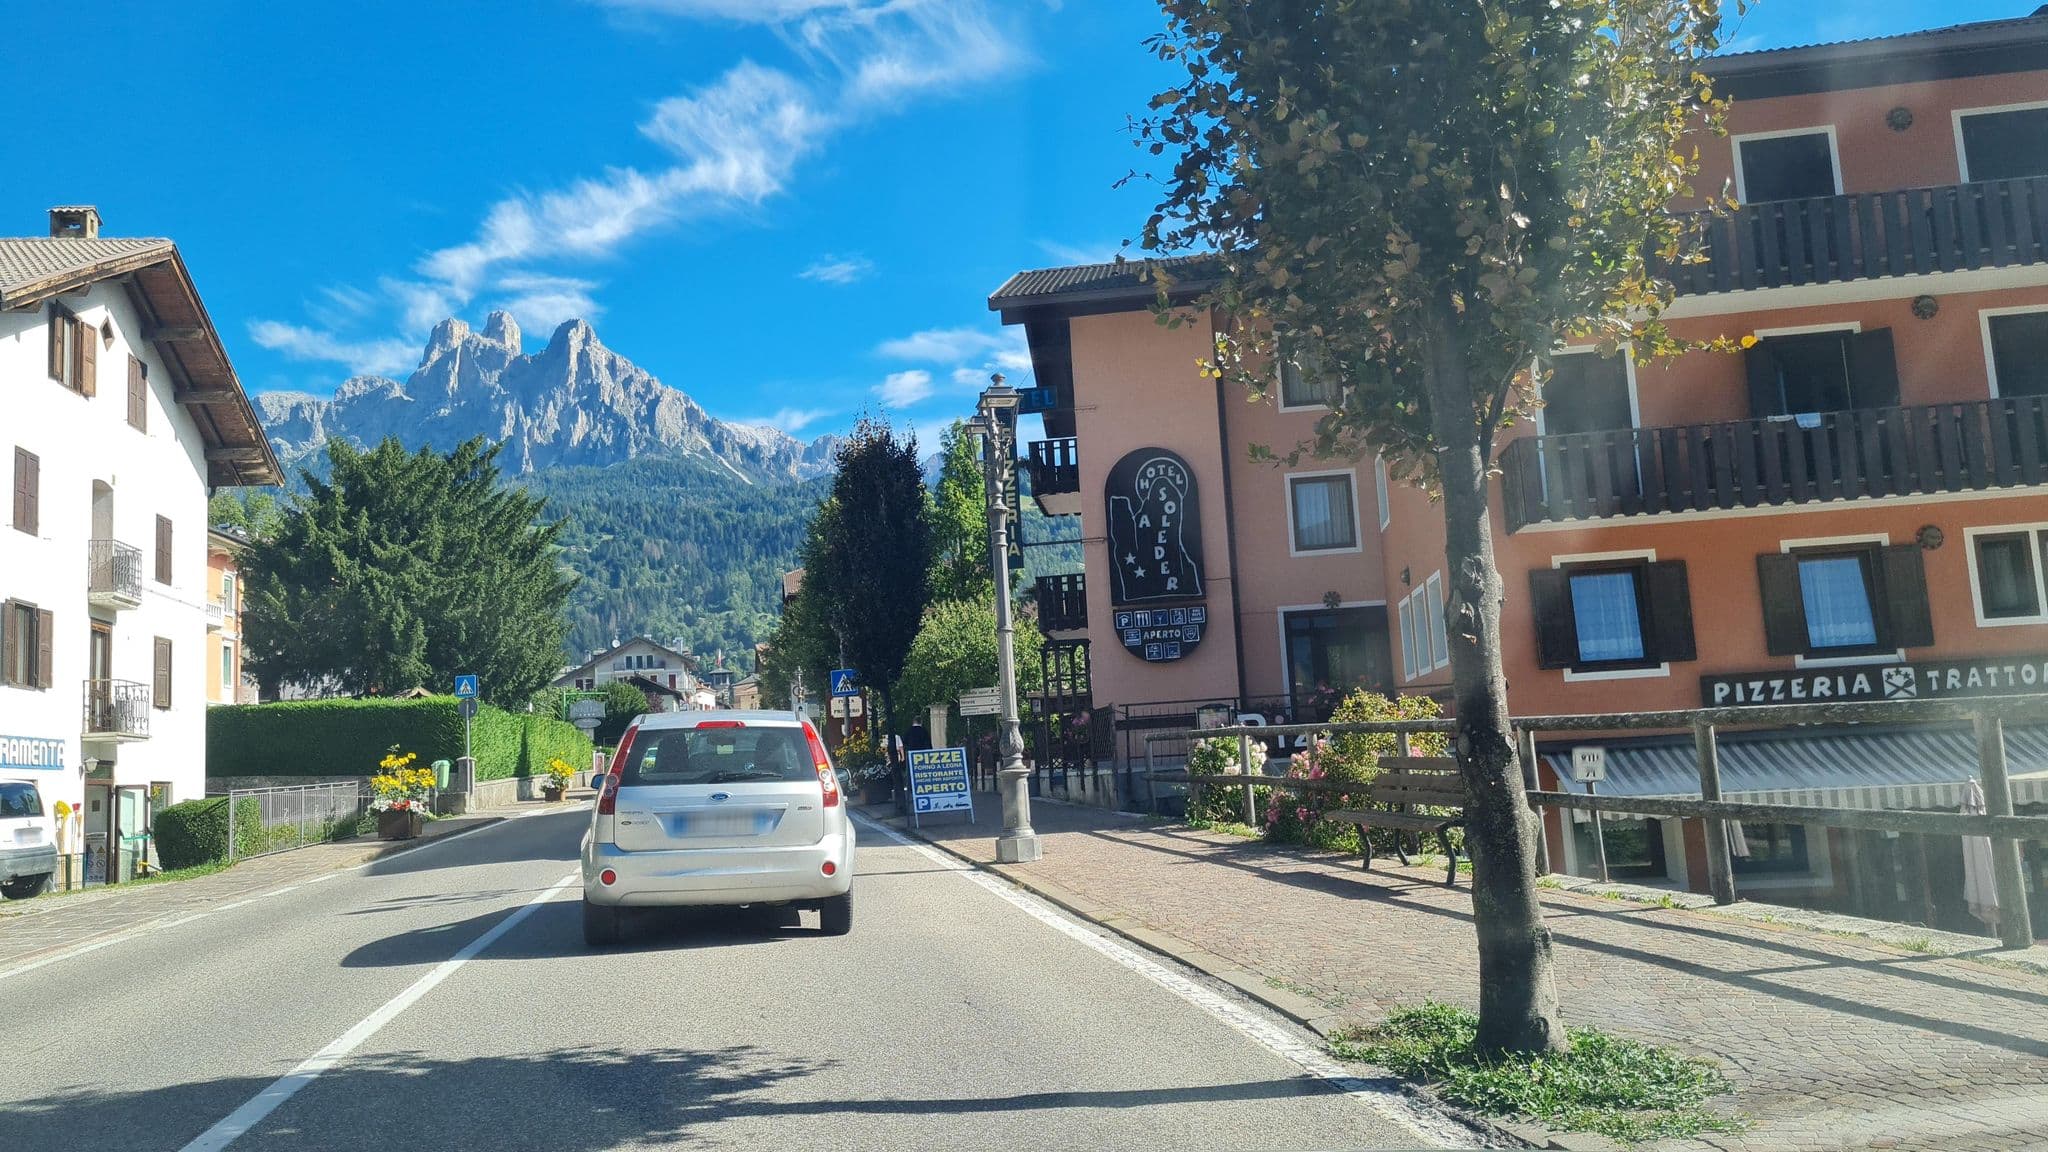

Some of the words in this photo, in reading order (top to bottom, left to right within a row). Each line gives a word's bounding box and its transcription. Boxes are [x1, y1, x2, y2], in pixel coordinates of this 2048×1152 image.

[1139, 464, 1184, 490] HOTEL
[1143, 629, 1181, 640] APERTO
[1713, 672, 1872, 704] PIZZERIA
[913, 751, 962, 764] PIZZE
[914, 770, 964, 778] RISTORANTE
[916, 782, 966, 794] APERTO
